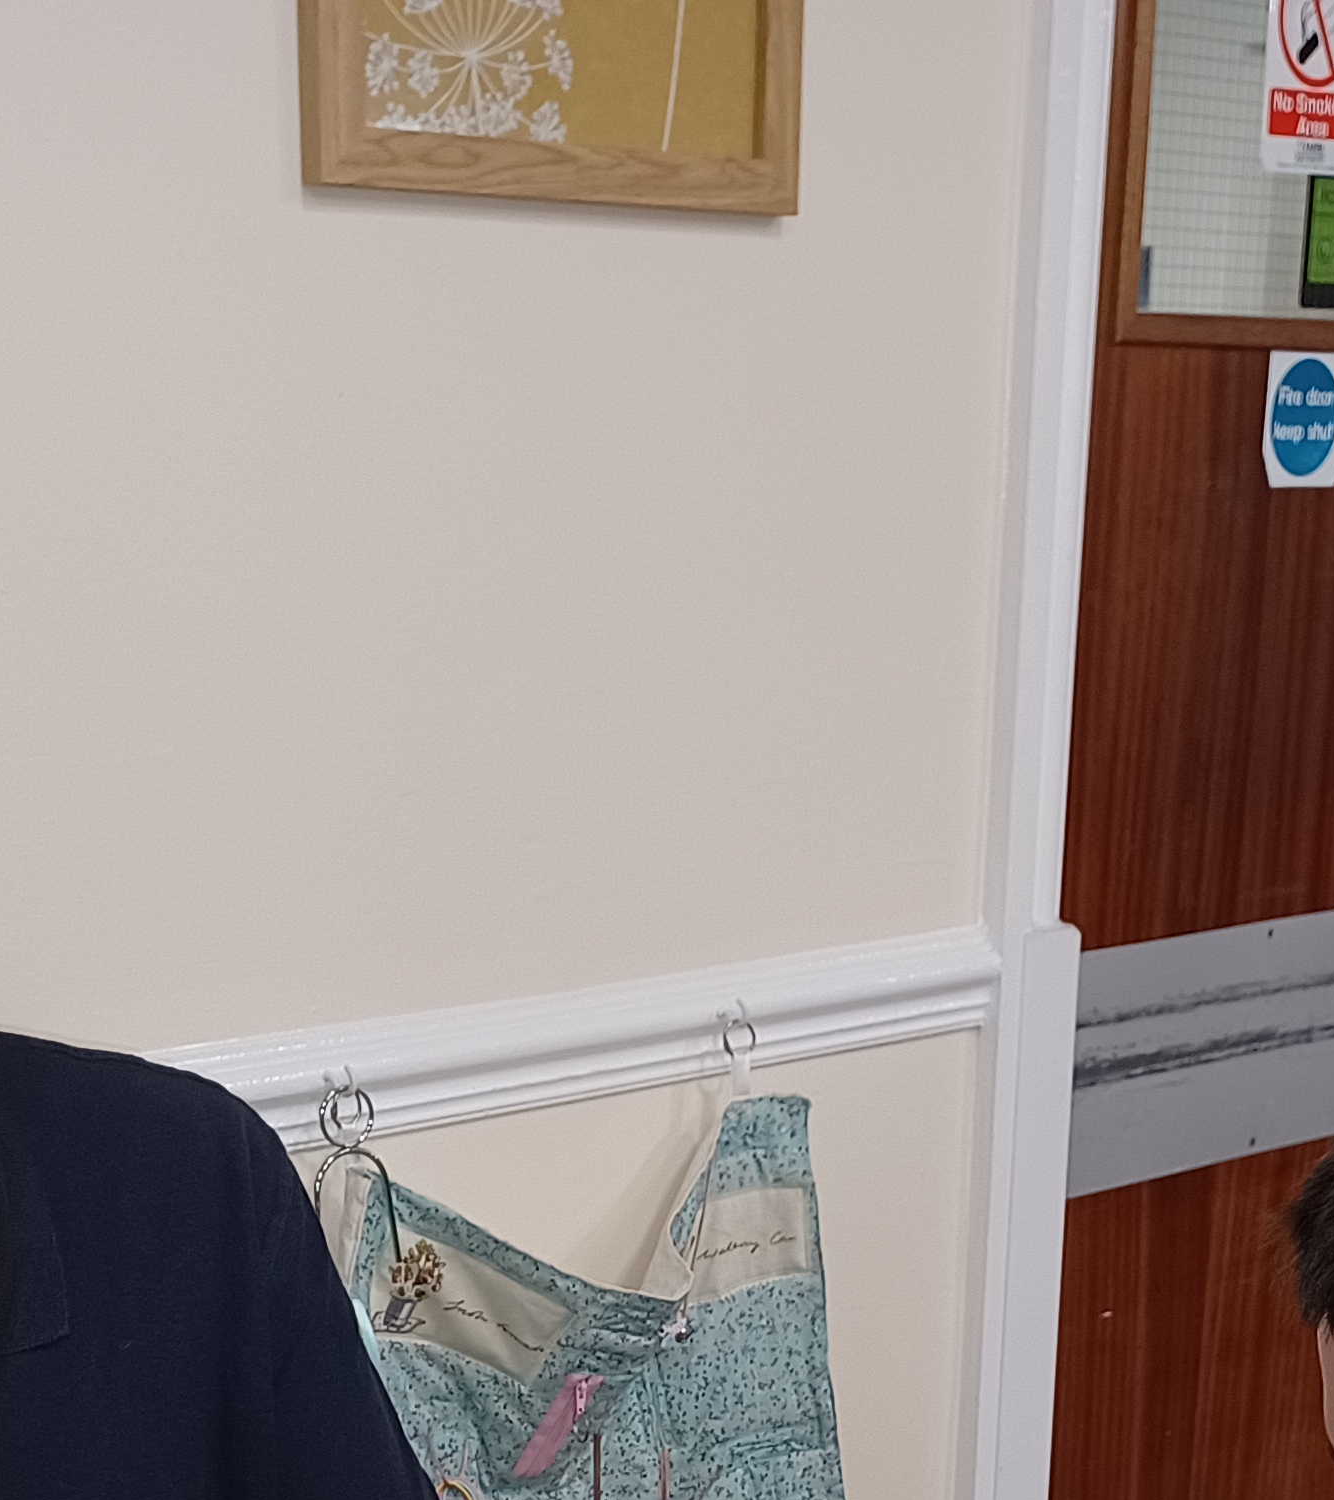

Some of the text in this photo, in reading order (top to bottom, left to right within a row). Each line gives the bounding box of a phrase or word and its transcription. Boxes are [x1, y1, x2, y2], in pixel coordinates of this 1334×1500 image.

[1272, 90, 1295, 114] No
[1296, 115, 1330, 138] Area
[1278, 384, 1334, 408] Fire door
[1272, 420, 1334, 445] keep shut
